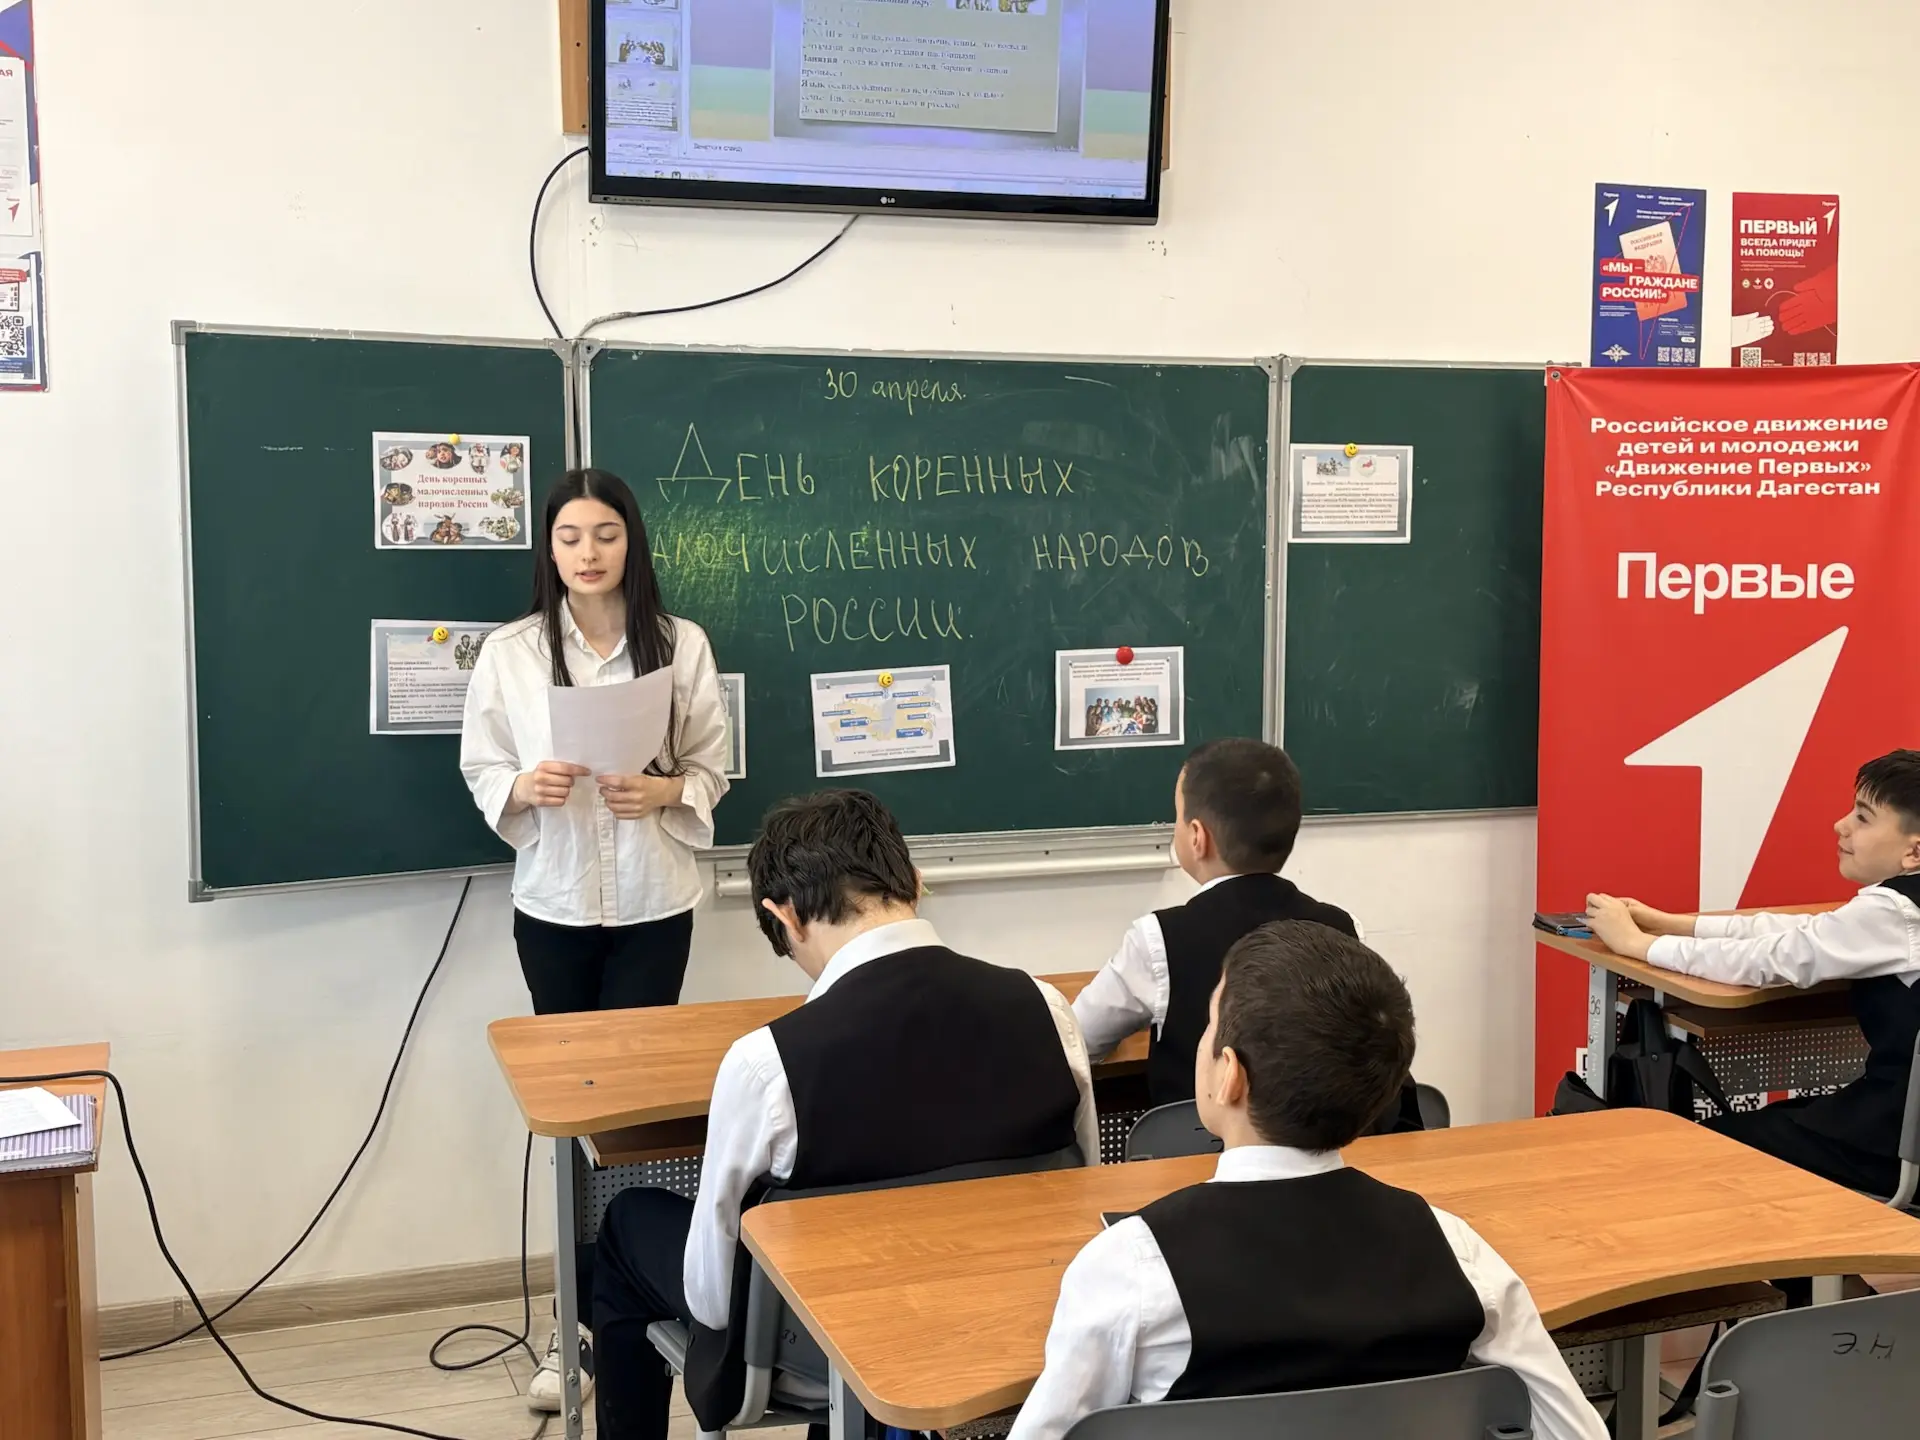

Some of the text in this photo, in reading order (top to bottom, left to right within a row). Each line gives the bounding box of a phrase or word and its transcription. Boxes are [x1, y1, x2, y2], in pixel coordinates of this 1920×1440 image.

[1740, 217, 1817, 234] ПЕРВЫЙ
[1740, 238, 1817, 248] ВСЕГДА ПРИДЕТ
[1756, 249, 1804, 258] ПОМОЩЬ!
[1602, 262, 1633, 273] «МЫ
[1628, 275, 1698, 289] ГРАЖДАНЕ
[1602, 287, 1667, 299] РОССИИ!»
[824, 368, 857, 400] 30
[1590, 416, 1889, 434] Российское движение
[1617, 437, 1860, 456] детей и молодежи
[869, 453, 1077, 501] КОРЕННЫХ
[1604, 459, 1872, 478] «Движение Первых»
[417, 474, 440, 485] День
[1595, 480, 1881, 499] Республики Дагестан
[457, 499, 488, 509] России
[1033, 531, 1210, 577] НАРОДОВ
[1617, 551, 1856, 616] Первые
